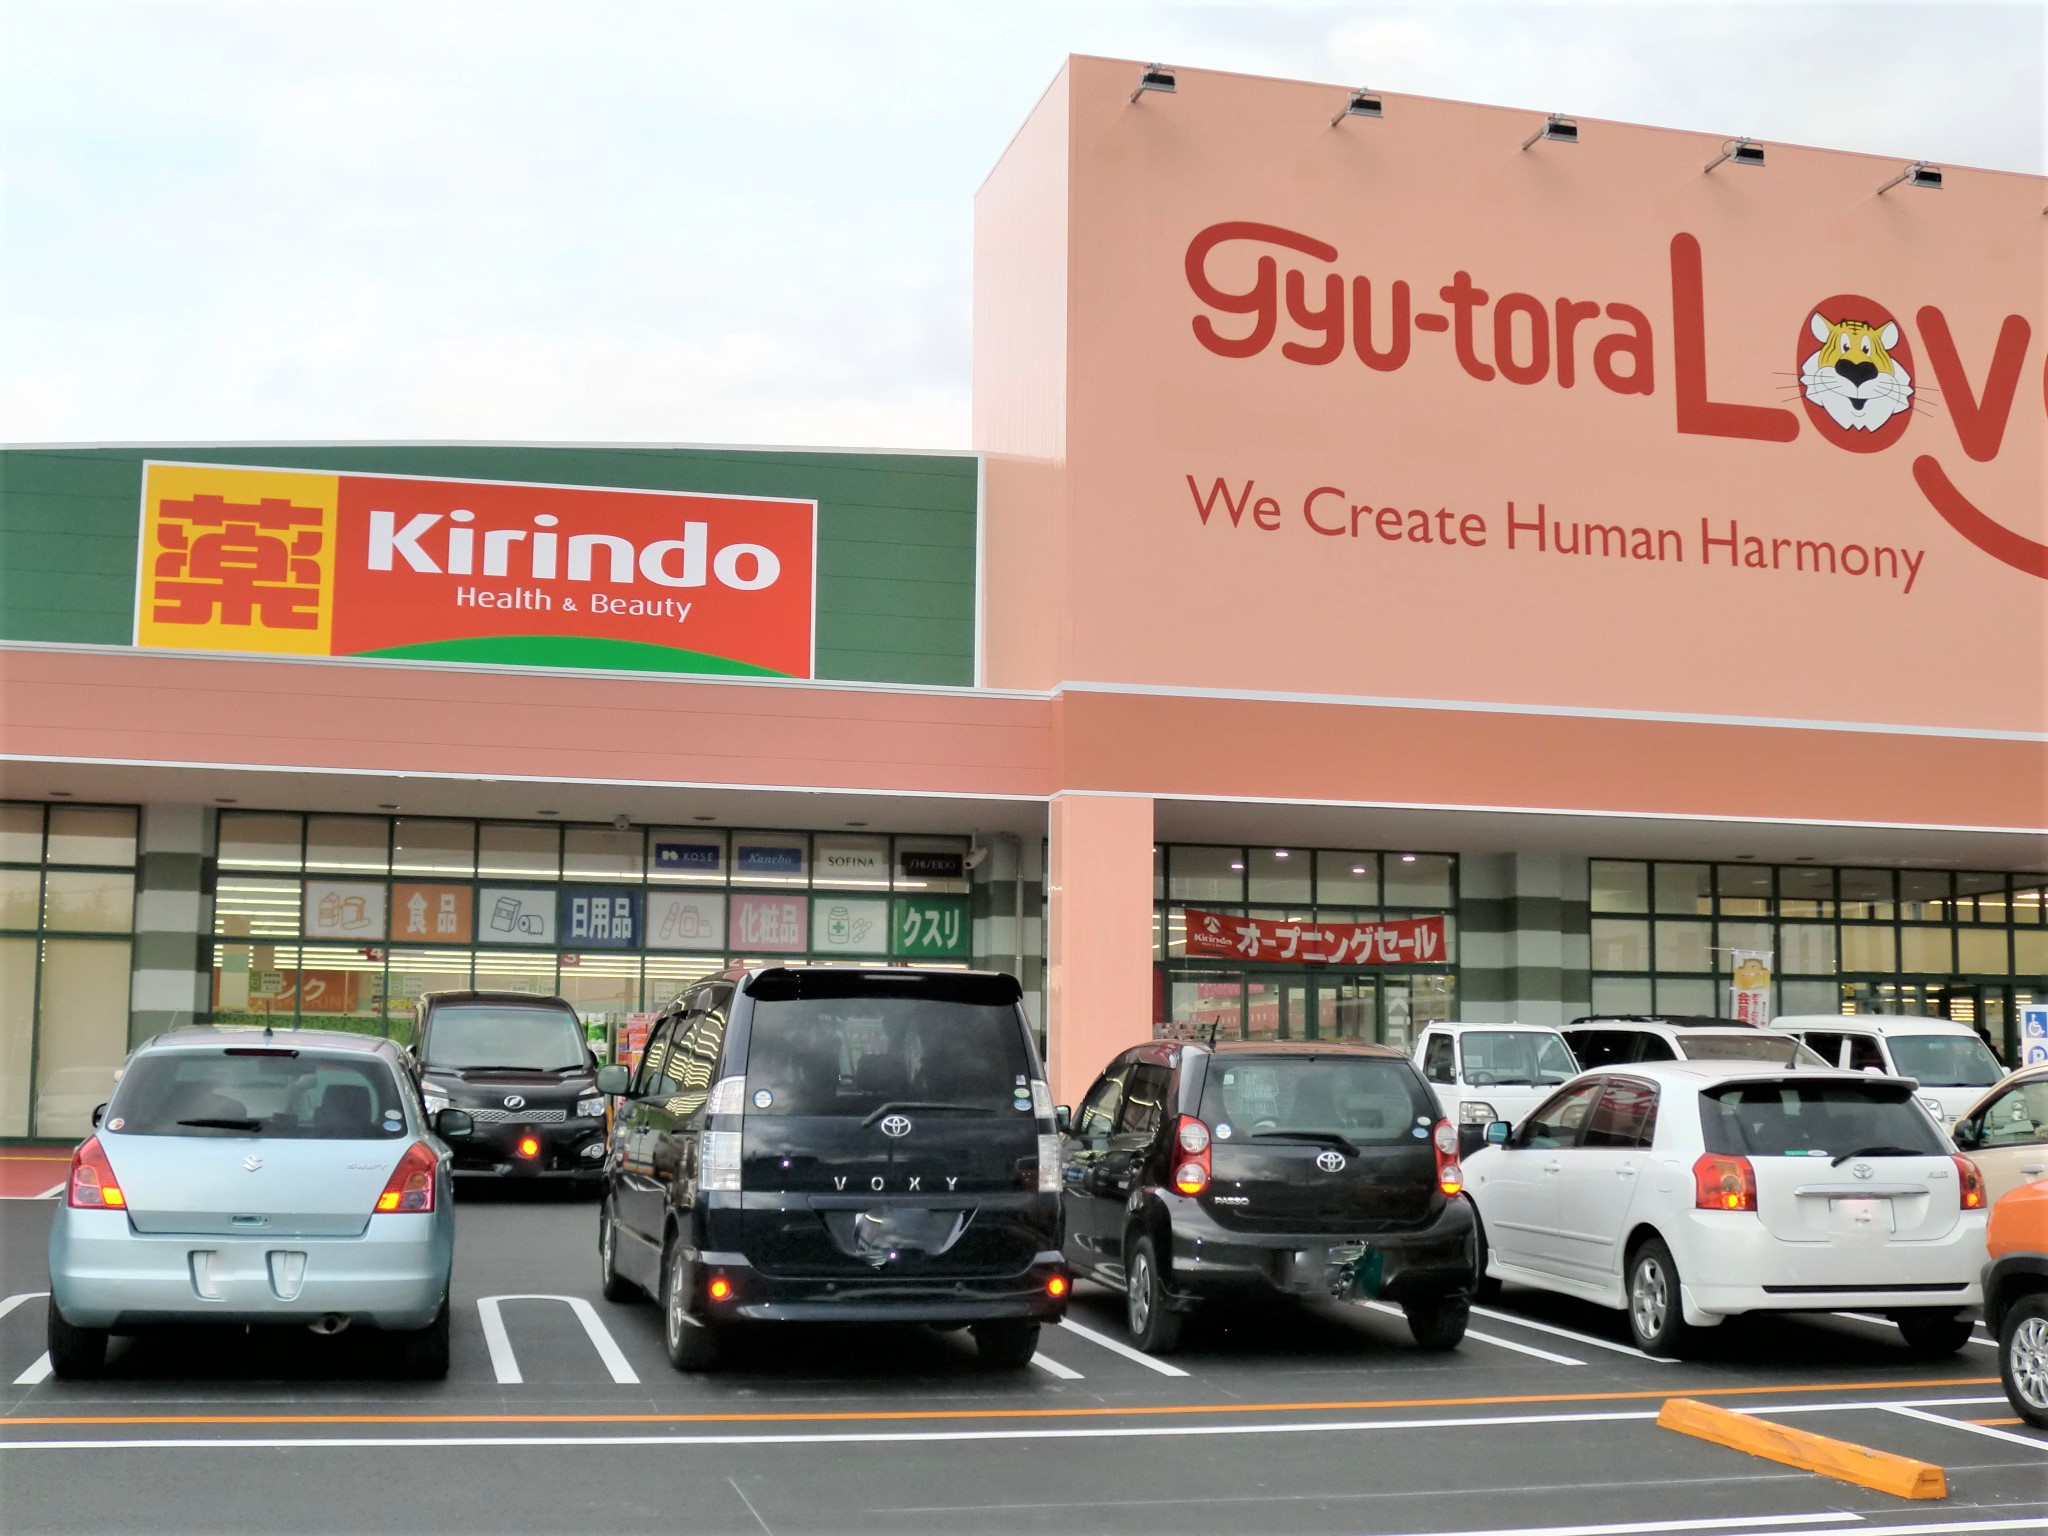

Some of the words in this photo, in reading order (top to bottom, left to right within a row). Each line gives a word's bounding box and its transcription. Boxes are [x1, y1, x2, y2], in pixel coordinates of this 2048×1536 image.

[1185, 221, 1656, 396] gyu-tora
[1670, 232, 2048, 462] Lov
[367, 509, 781, 591] Kirindo
[1186, 474, 1281, 530] We
[1303, 486, 1487, 547] Create
[1506, 501, 1684, 563] Human
[1701, 517, 1925, 595] Harmony
[456, 585, 553, 612] Health
[562, 596, 578, 612] &
[591, 591, 692, 622] Beauty
[748, 853, 792, 865] Kanebo
[828, 856, 875, 868] SOFINA
[908, 859, 956, 870] SHISEIDO
[406, 892, 456, 934] 食品
[572, 898, 632, 939] 日用品
[739, 903, 799, 944] 化粧品
[903, 907, 960, 949] クスリ
[1194, 933, 1233, 945] Kirindo
[1236, 922, 1438, 964] オープニングセール
[1738, 993, 1750, 1021] 会員
[347, 1162, 387, 1170] SWIFT
[834, 1176, 958, 1191] VOXY
[1214, 1197, 1250, 1205] PASSO
